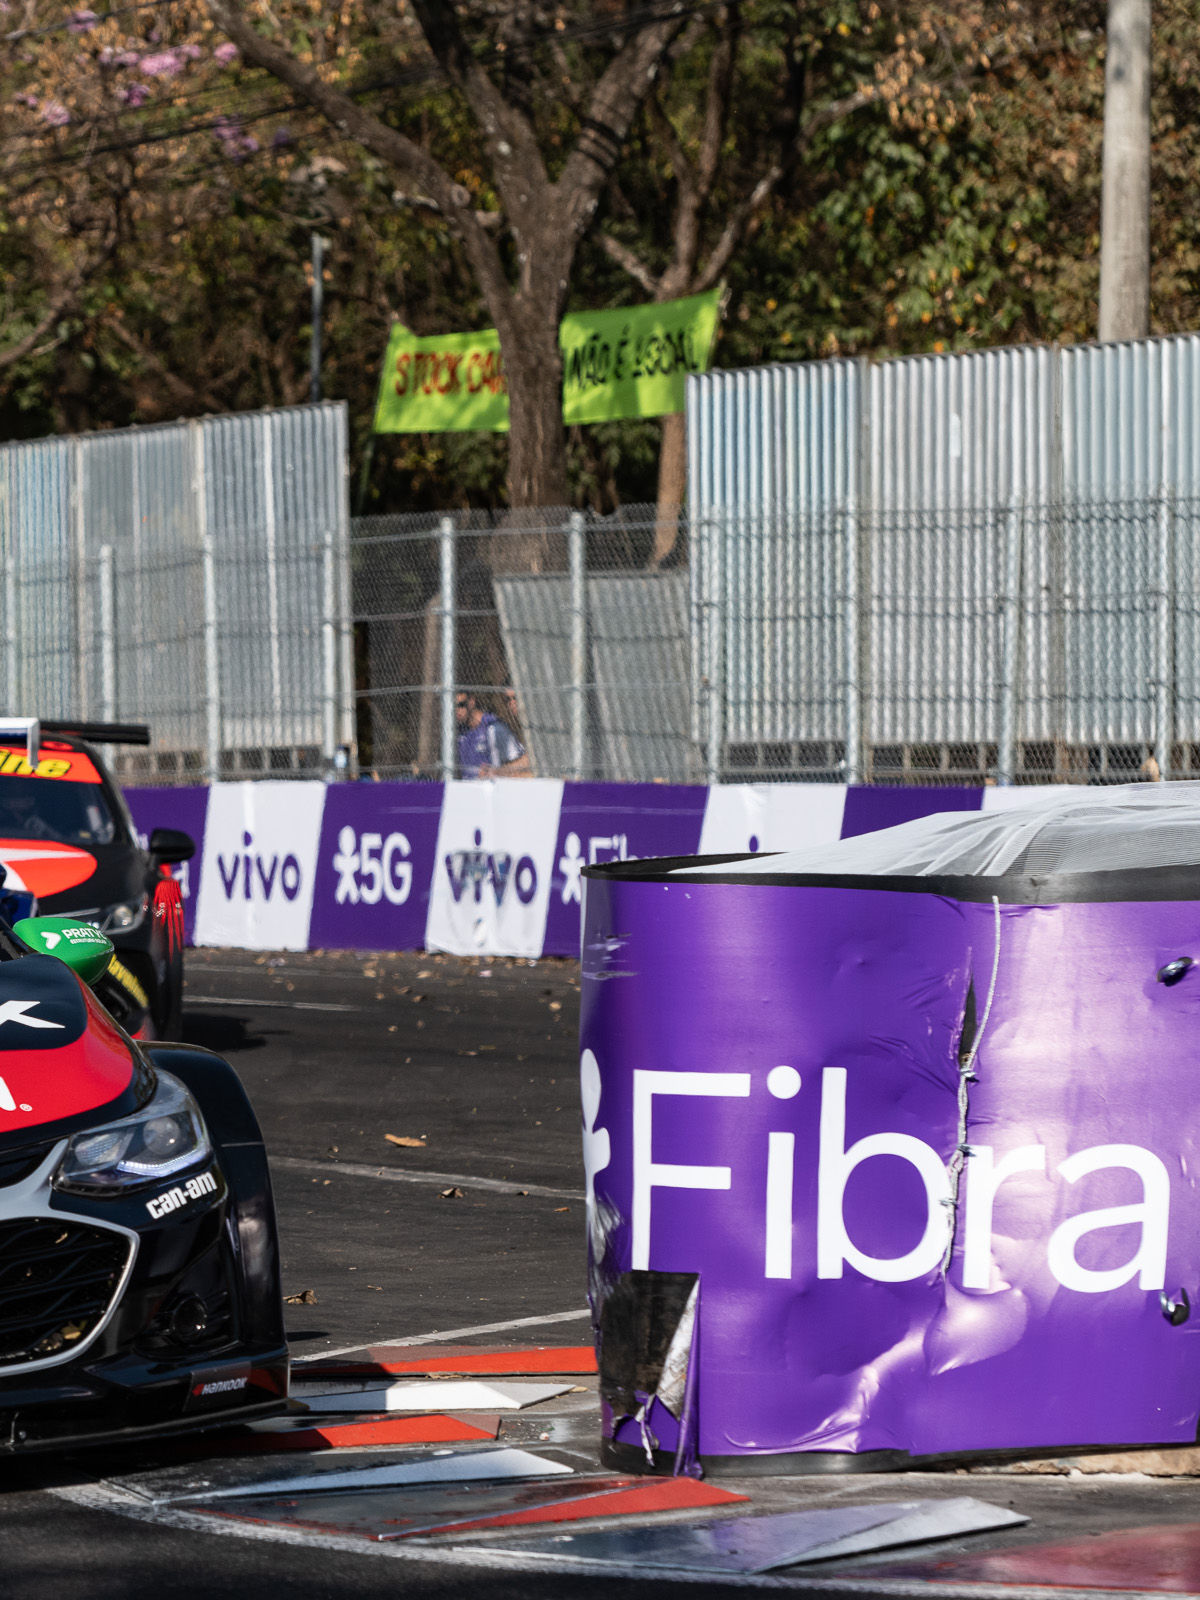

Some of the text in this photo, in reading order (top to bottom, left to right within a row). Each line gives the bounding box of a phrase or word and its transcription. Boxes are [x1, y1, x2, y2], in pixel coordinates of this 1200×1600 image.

[217, 829, 302, 901] vivo
[359, 831, 413, 905] 5G
[445, 827, 538, 905] vivo
[61, 927, 108, 940] PRATYC
[146, 1171, 218, 1220] can-am
[631, 1065, 1170, 1294] Fibra
